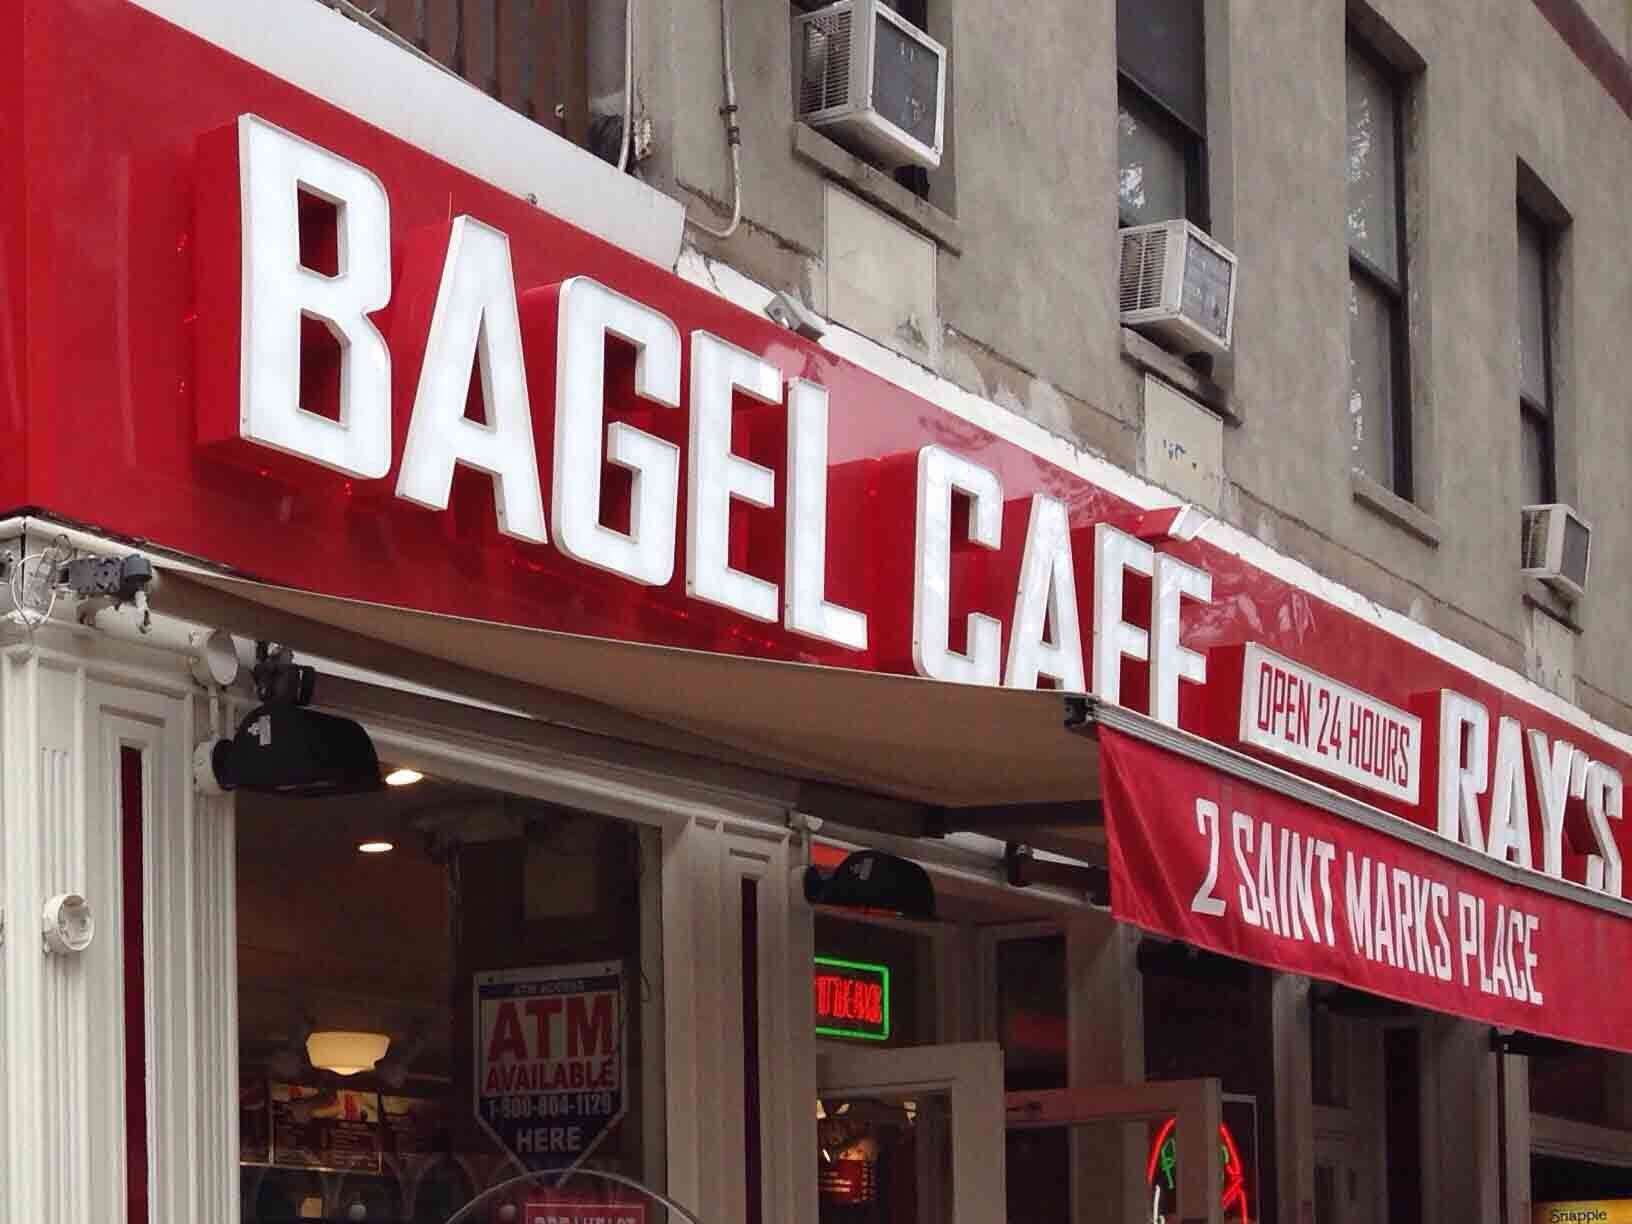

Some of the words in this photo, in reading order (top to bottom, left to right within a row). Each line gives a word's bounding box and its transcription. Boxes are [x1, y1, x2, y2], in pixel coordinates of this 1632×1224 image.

[238, 112, 868, 651] BAGEL
[1257, 662, 1311, 748] OPEN
[1317, 689, 1342, 760] 24
[1348, 702, 1410, 788] HOURS
[1438, 688, 1623, 897] RAY'S
[1191, 799, 1227, 917] 2
[1232, 813, 1336, 948] SAINT
[1344, 852, 1452, 981] MARKS
[1458, 892, 1543, 1005] PLACE
[486, 1058, 617, 1092] AVAILABLE
[487, 992, 617, 1062] ATM
[518, 1127, 583, 1152] HERE
[1551, 1208, 1608, 1224] Snapple
